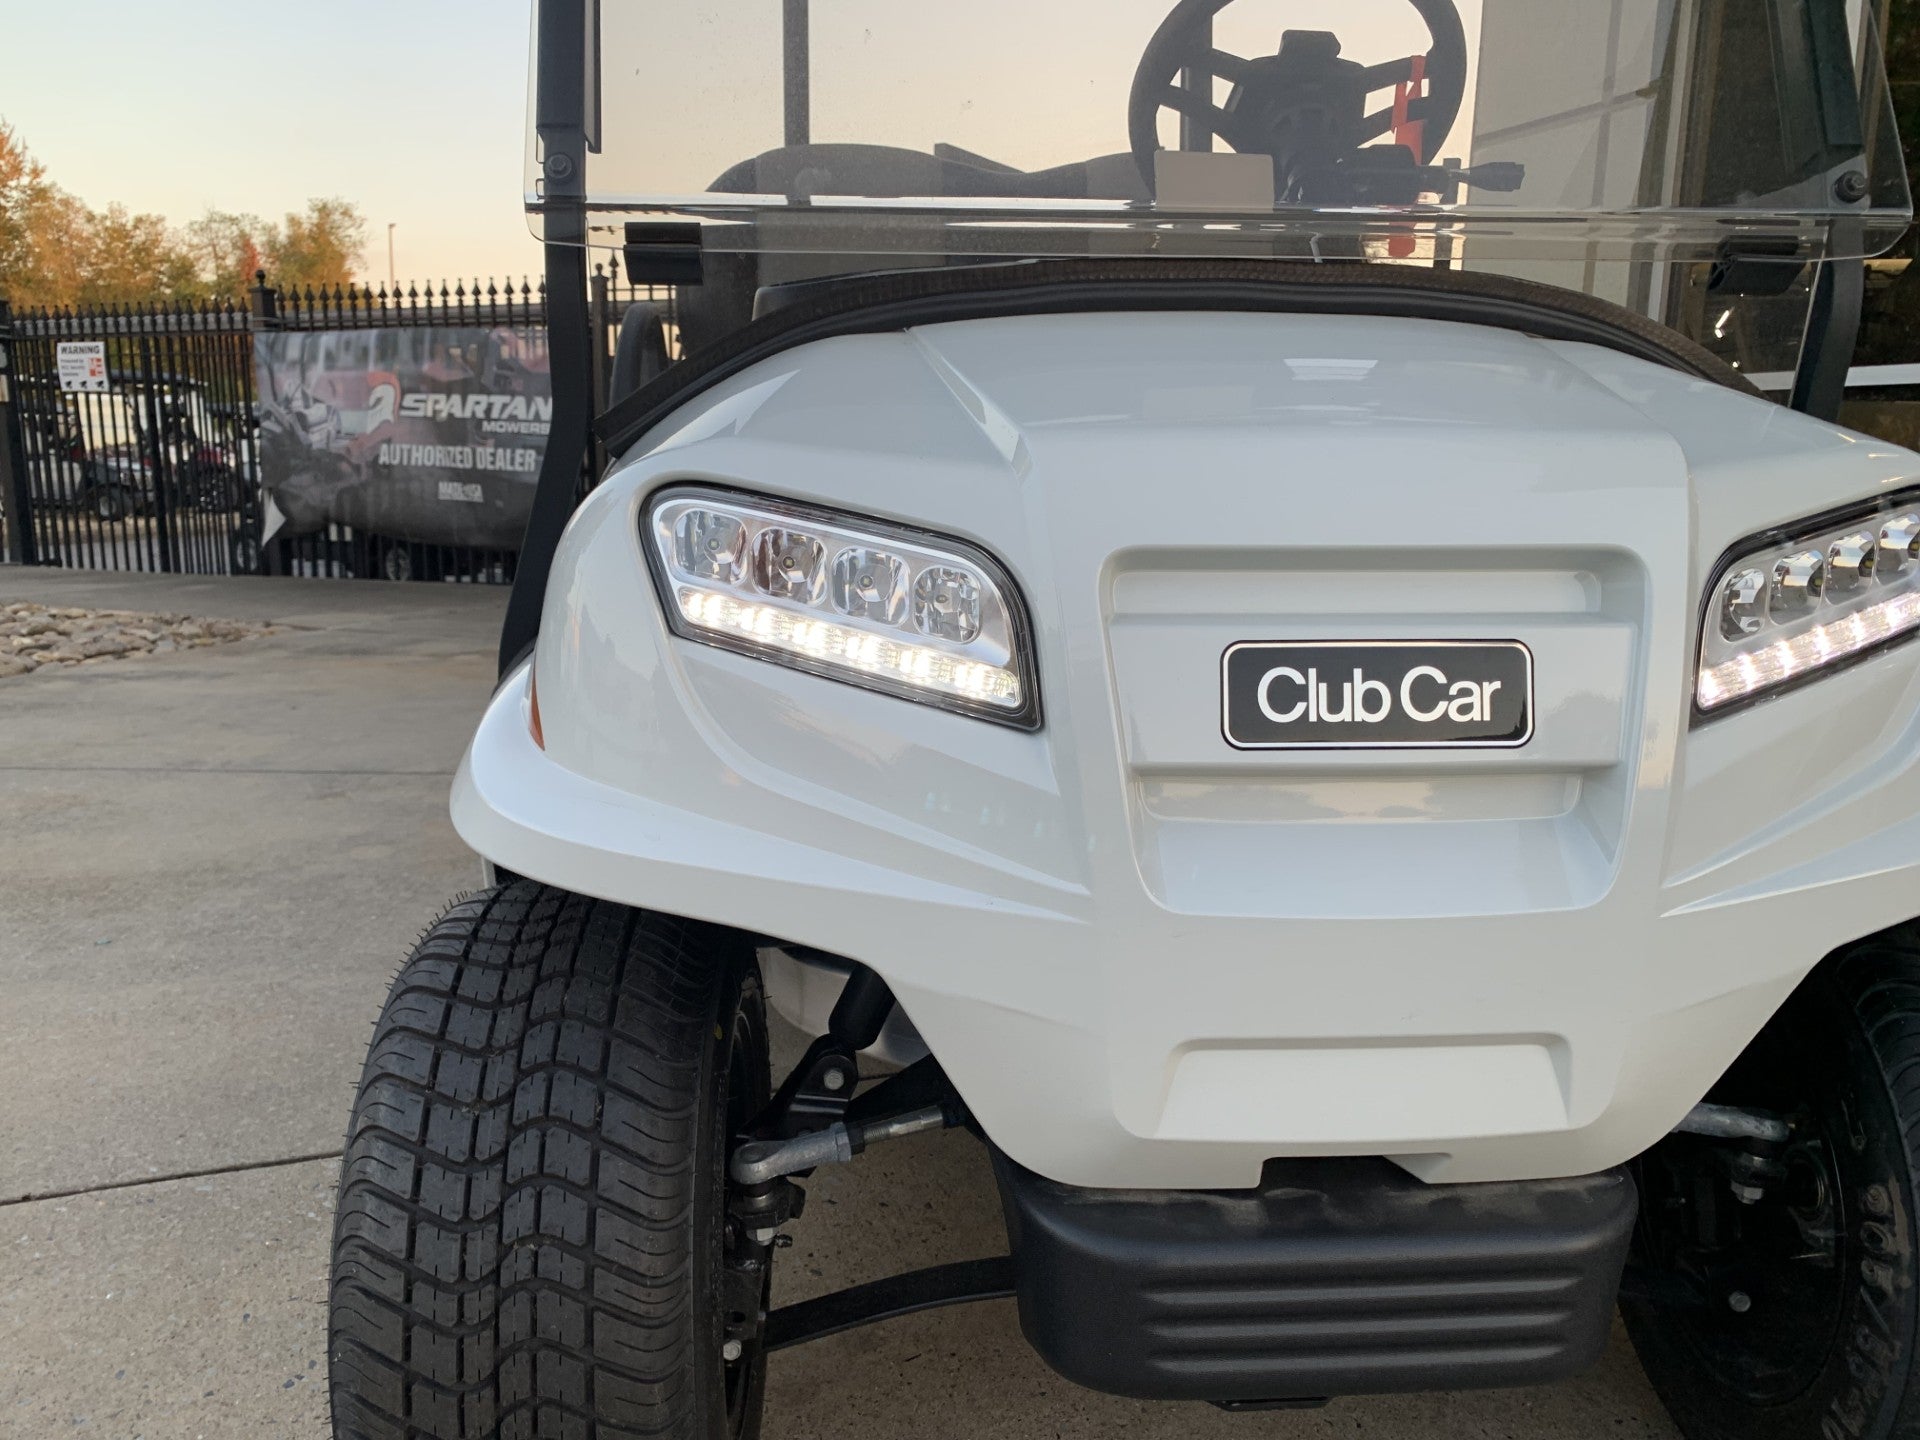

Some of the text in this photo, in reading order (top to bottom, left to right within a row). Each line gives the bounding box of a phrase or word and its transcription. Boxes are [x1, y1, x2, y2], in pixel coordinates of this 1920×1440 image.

[60, 345, 100, 354] WARNING
[400, 393, 552, 420] SPARTAN
[482, 420, 550, 435] MOWERS
[378, 444, 537, 472] AUTHORIZED DEALER
[1257, 665, 1502, 723] Club Car
